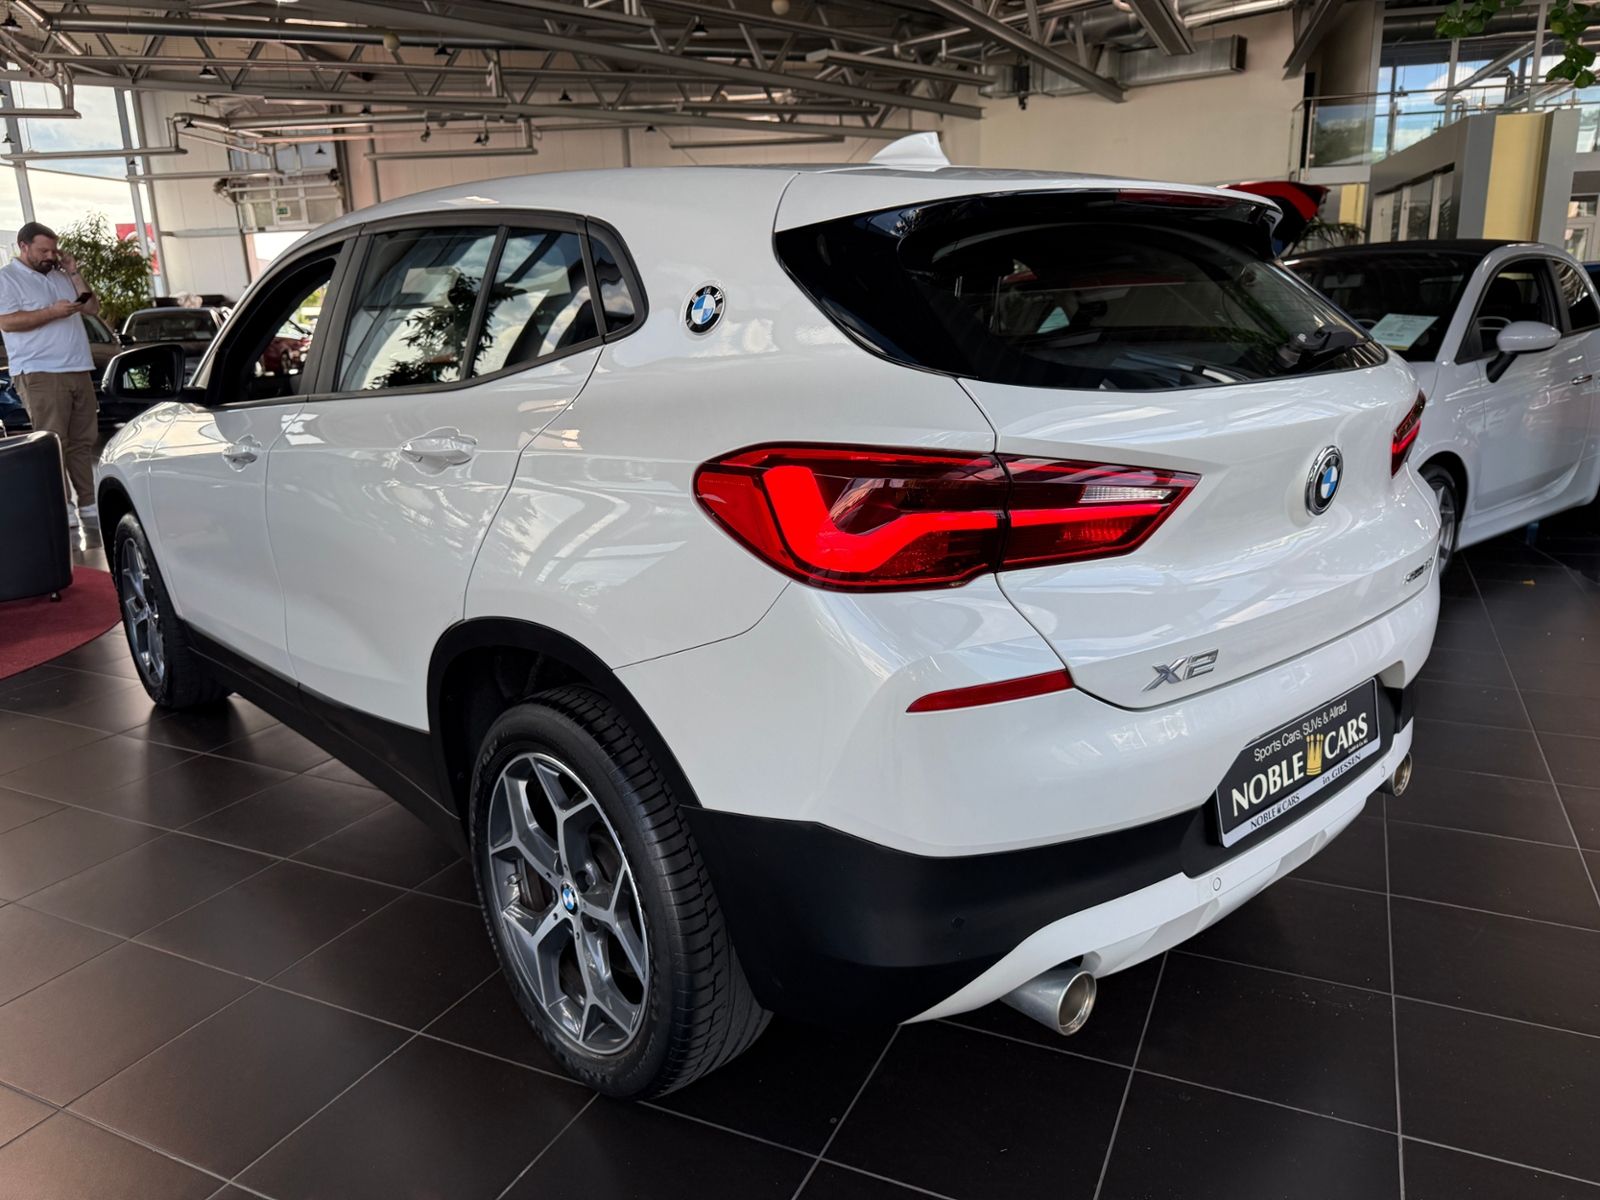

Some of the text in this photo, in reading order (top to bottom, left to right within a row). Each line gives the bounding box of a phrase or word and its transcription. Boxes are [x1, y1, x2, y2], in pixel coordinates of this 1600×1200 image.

[1142, 648, 1219, 691] X2
[1253, 700, 1348, 762] Sports Cars, SUVs & Allrad
[1231, 712, 1368, 817] NOBLE CARS
[1322, 753, 1362, 785] in GIESSEN
[1250, 793, 1301, 830] NOBLE CARS
